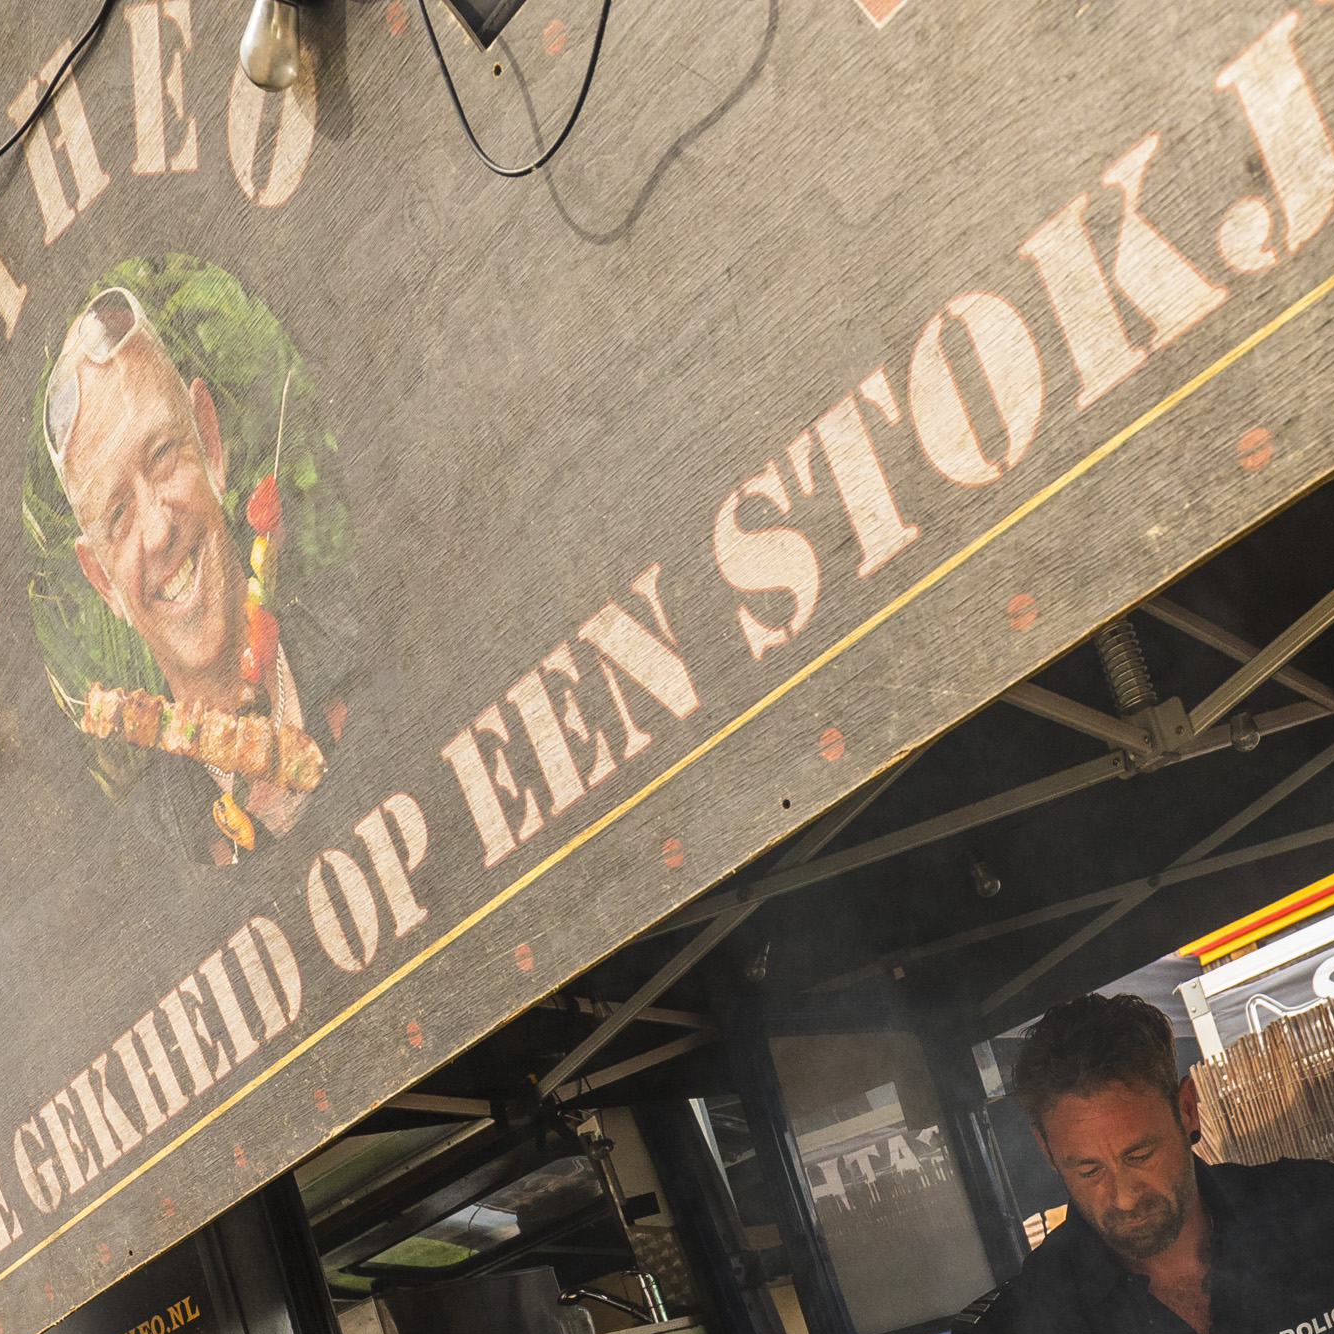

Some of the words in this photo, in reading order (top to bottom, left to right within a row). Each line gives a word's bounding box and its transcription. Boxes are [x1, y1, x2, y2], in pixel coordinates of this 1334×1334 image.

[12, 914, 303, 1214] GEKHEID
[305, 791, 431, 974] OP
[442, 564, 701, 868] EEN
